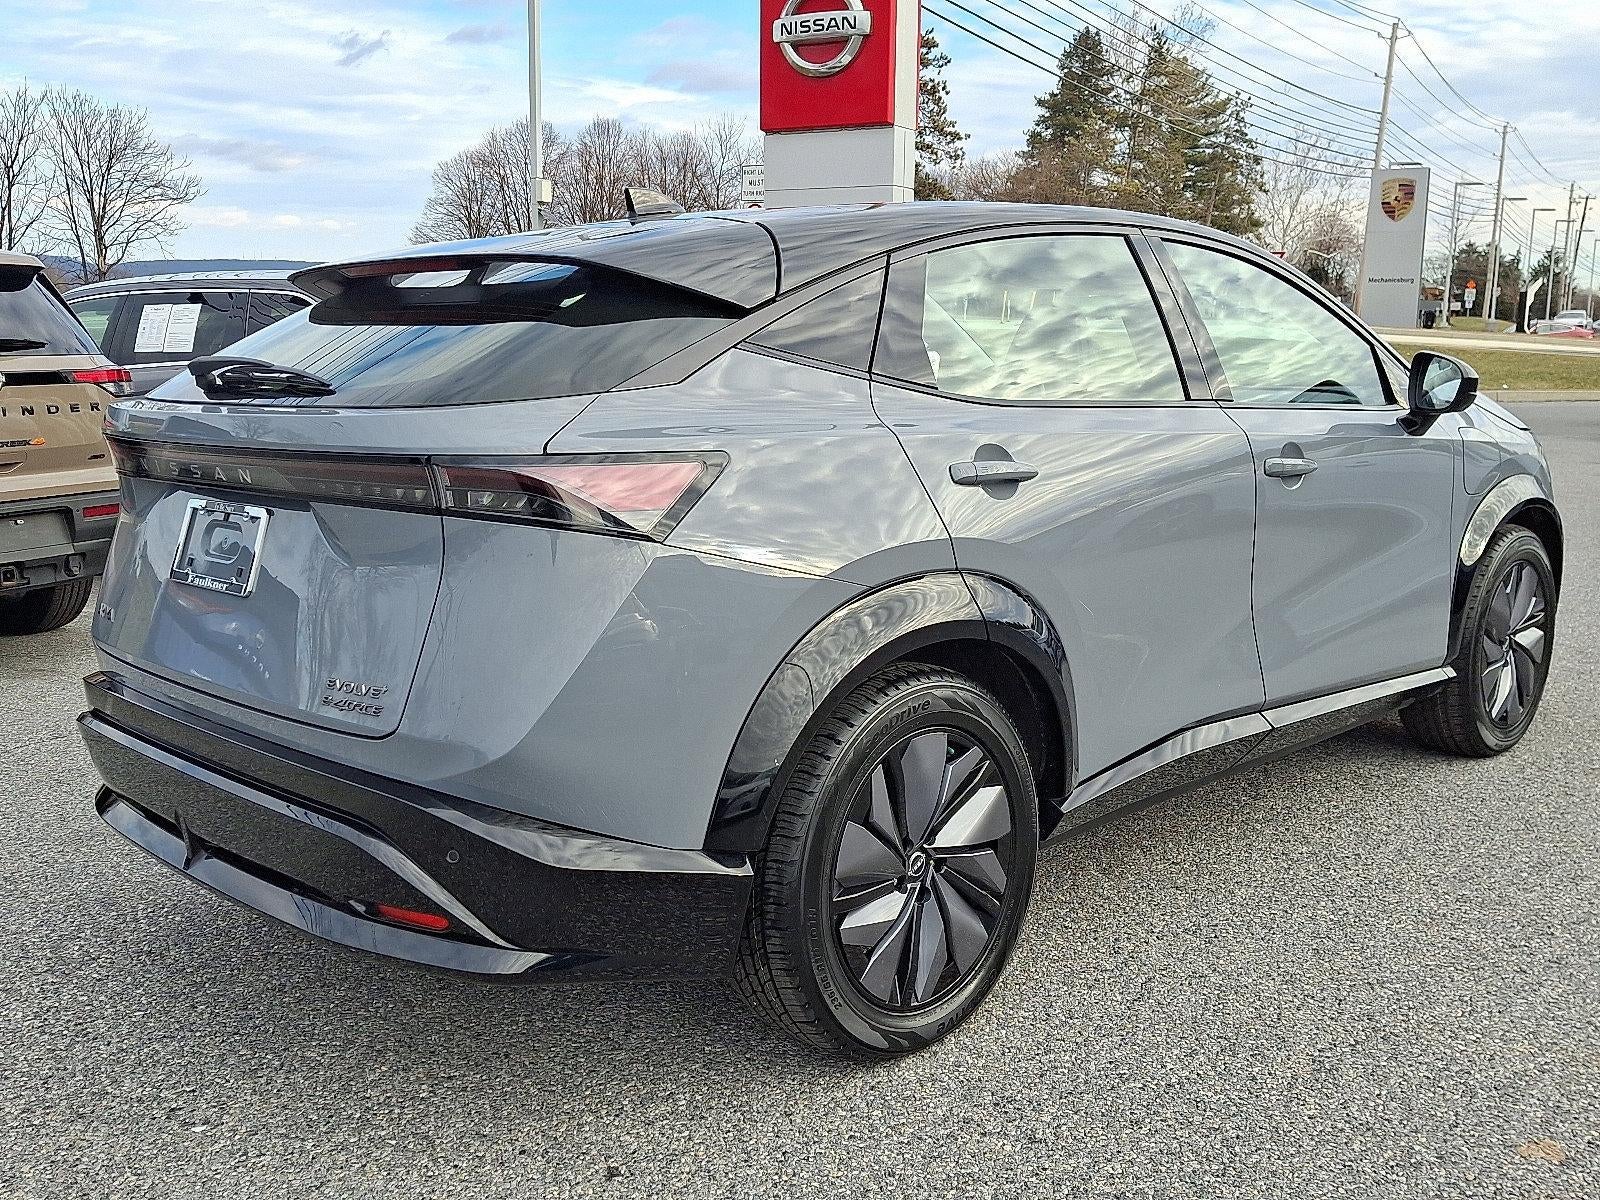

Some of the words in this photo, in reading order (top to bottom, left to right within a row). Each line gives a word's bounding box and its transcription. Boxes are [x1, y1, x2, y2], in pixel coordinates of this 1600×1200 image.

[781, 15, 857, 37] NISSAN
[1368, 277, 1415, 285] Mechanicsburg
[140, 457, 253, 485] NISSAN
[187, 574, 230, 591] Faulkner
